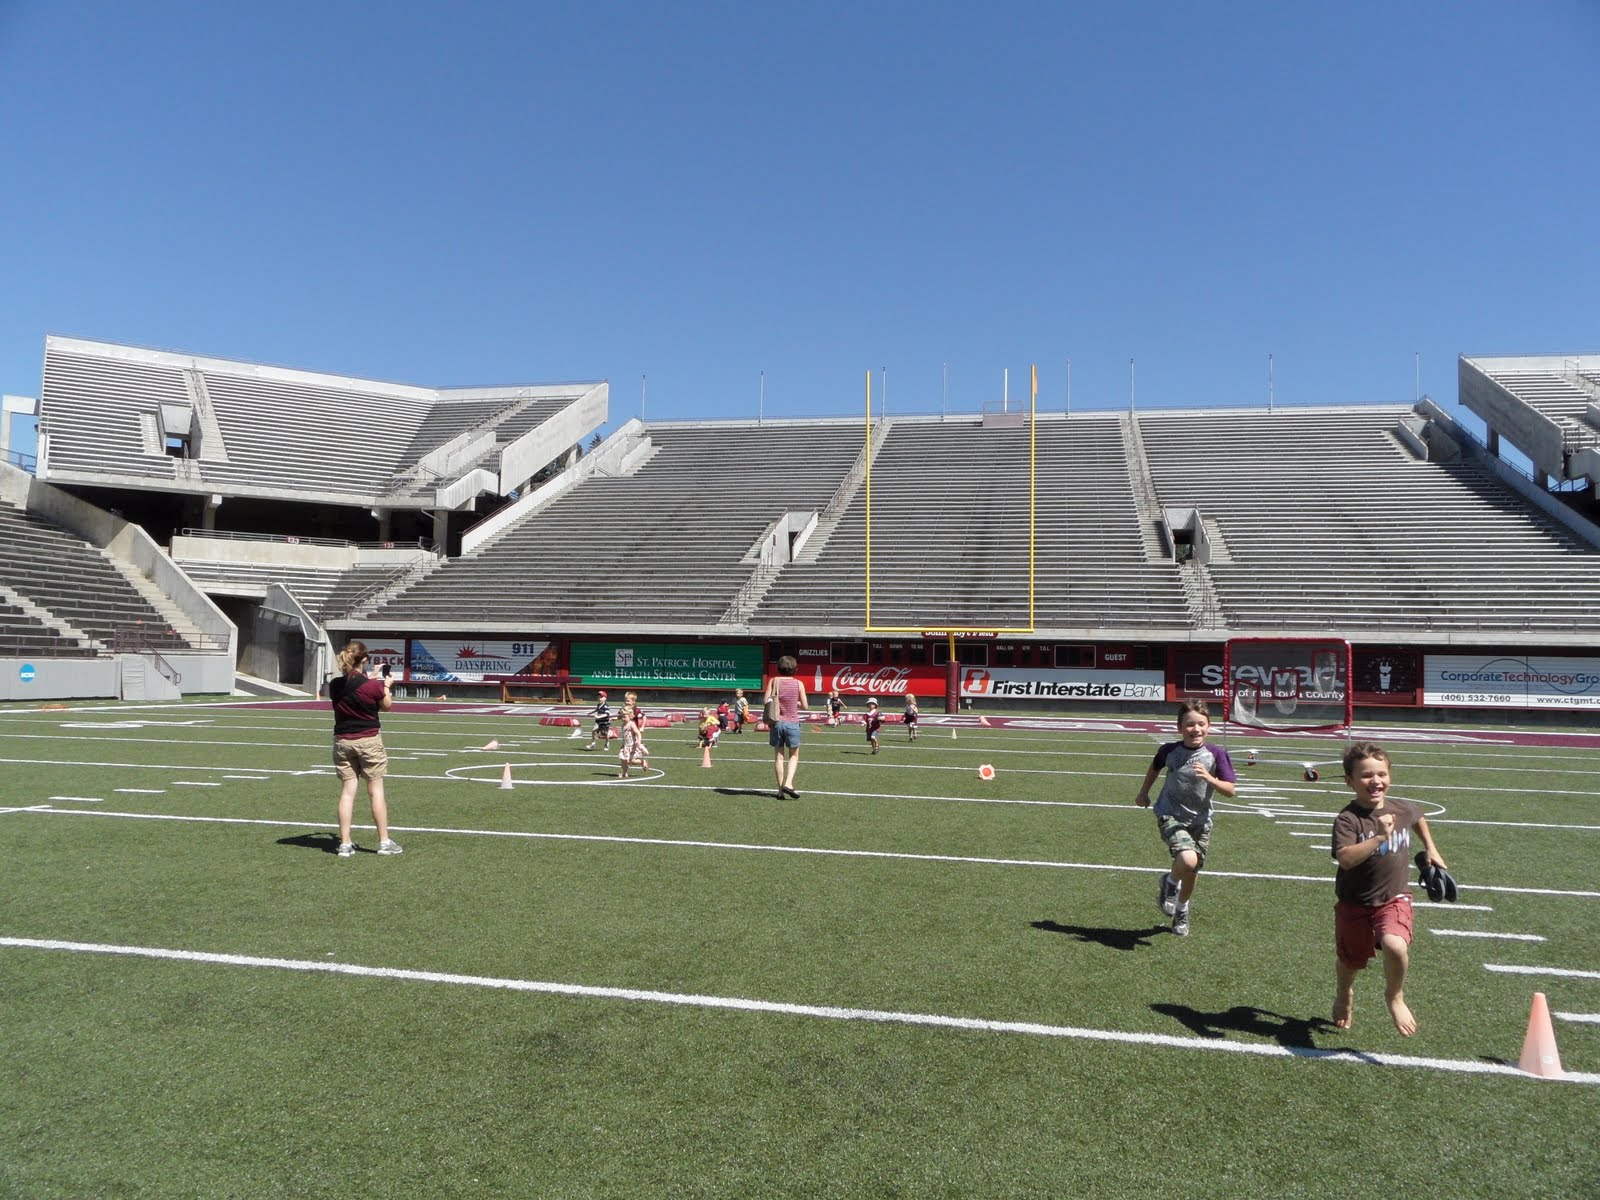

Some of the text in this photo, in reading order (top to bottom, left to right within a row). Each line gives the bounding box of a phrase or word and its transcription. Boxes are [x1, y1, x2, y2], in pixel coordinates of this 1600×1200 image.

[287, 536, 299, 545] 133
[512, 643, 534, 654] 911
[799, 649, 829, 657] GRIZZLIES
[1104, 653, 1127, 661] GUEST
[455, 660, 512, 671] DAYSPRING
[832, 666, 912, 693] Coca-Cola
[992, 680, 1161, 698] First Interstate Bank
[1214, 688, 1234, 697] tite
[1238, 689, 1249, 697] of
[1305, 690, 1345, 701] county
[1441, 694, 1511, 702] (406) 532-7660
